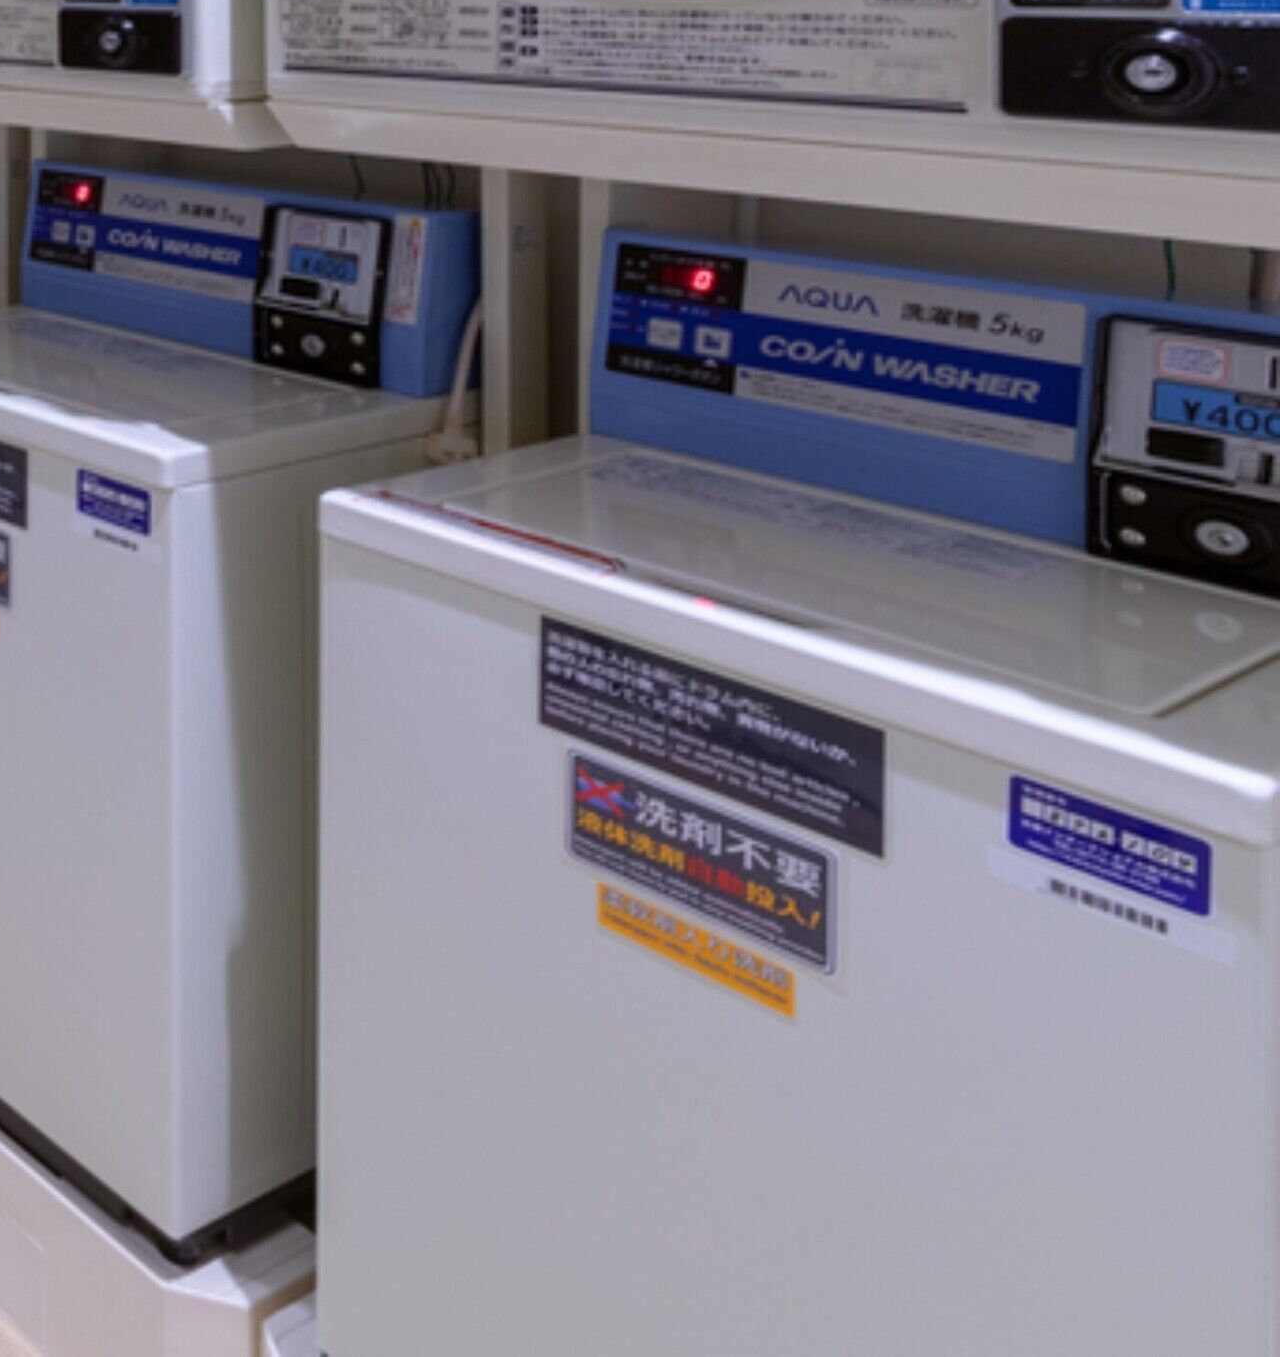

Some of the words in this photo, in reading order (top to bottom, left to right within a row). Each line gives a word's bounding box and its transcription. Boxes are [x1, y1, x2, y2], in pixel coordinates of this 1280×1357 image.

[778, 284, 880, 318] AQUA
[988, 312, 1045, 344] 5kg
[873, 354, 1041, 404] WASHER
[635, 789, 822, 898] 洗剤不要
